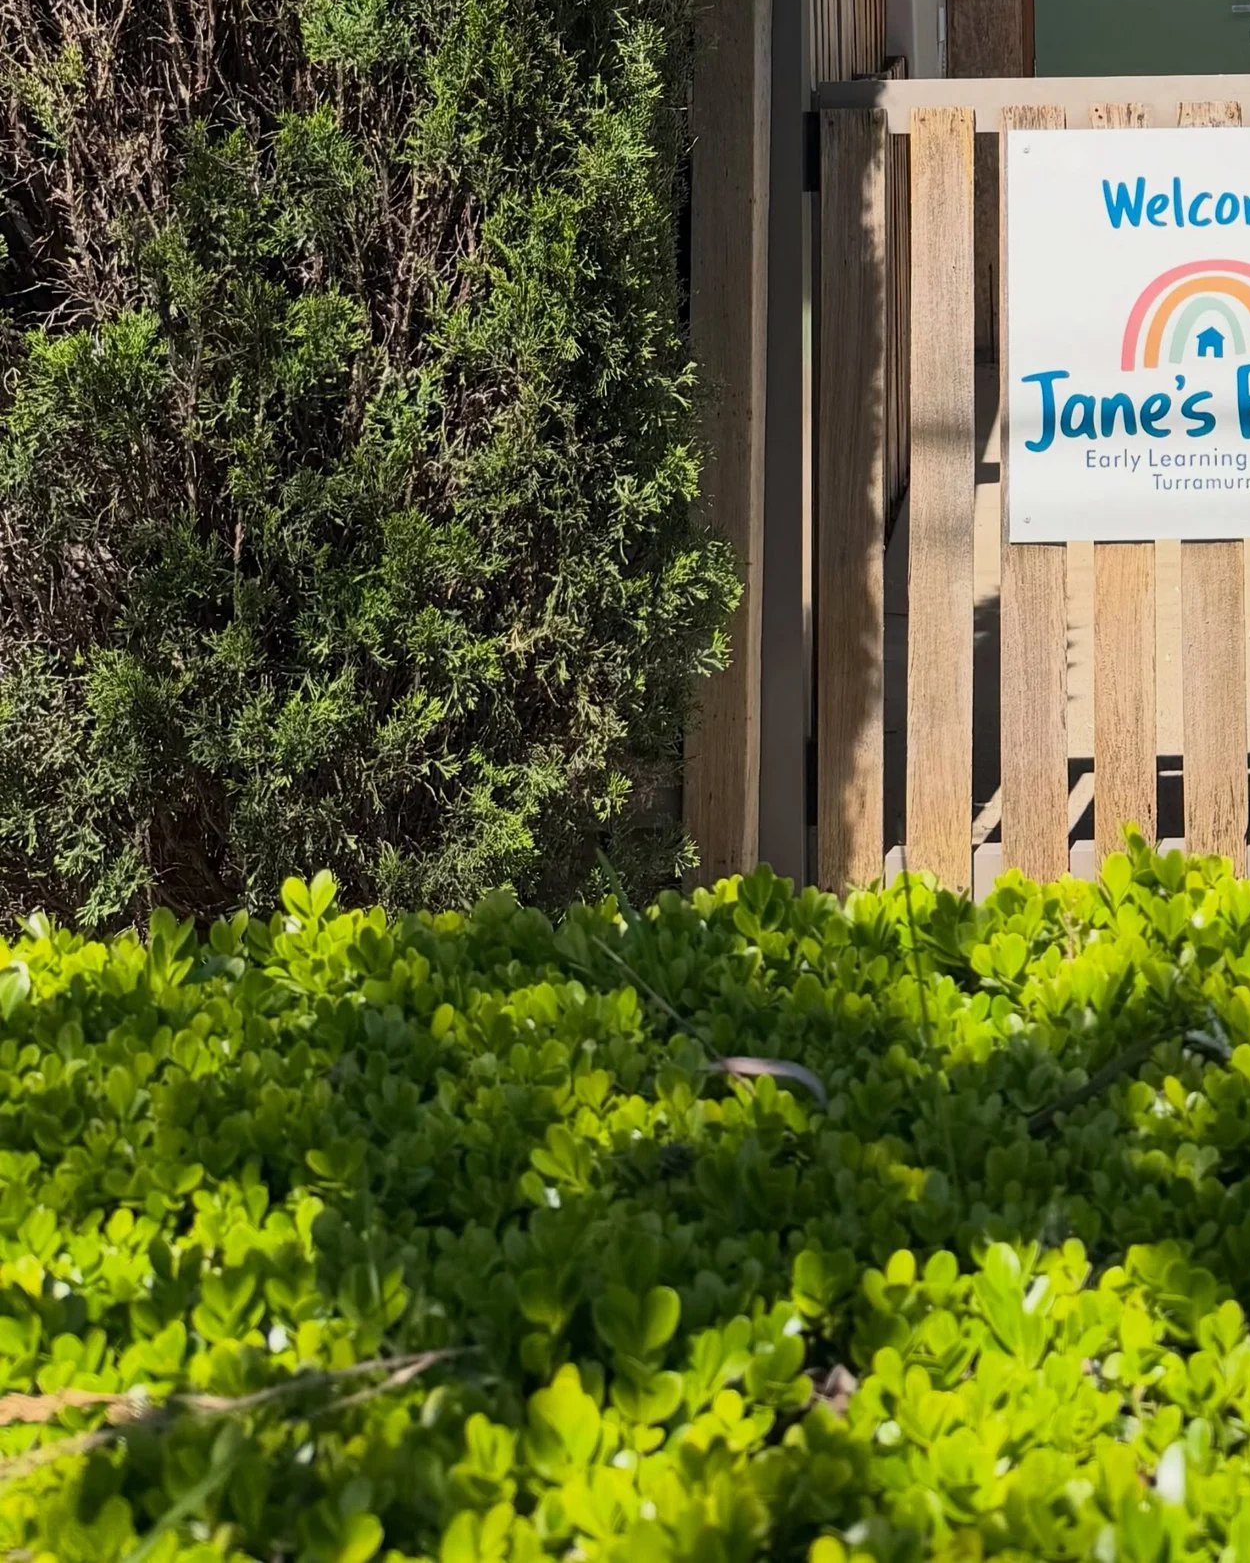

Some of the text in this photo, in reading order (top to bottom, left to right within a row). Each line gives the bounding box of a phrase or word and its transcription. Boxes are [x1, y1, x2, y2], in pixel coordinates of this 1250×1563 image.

[1021, 369, 1217, 453] Jane's
[1086, 449, 1141, 473] Early
[1149, 448, 1247, 471] Learning
